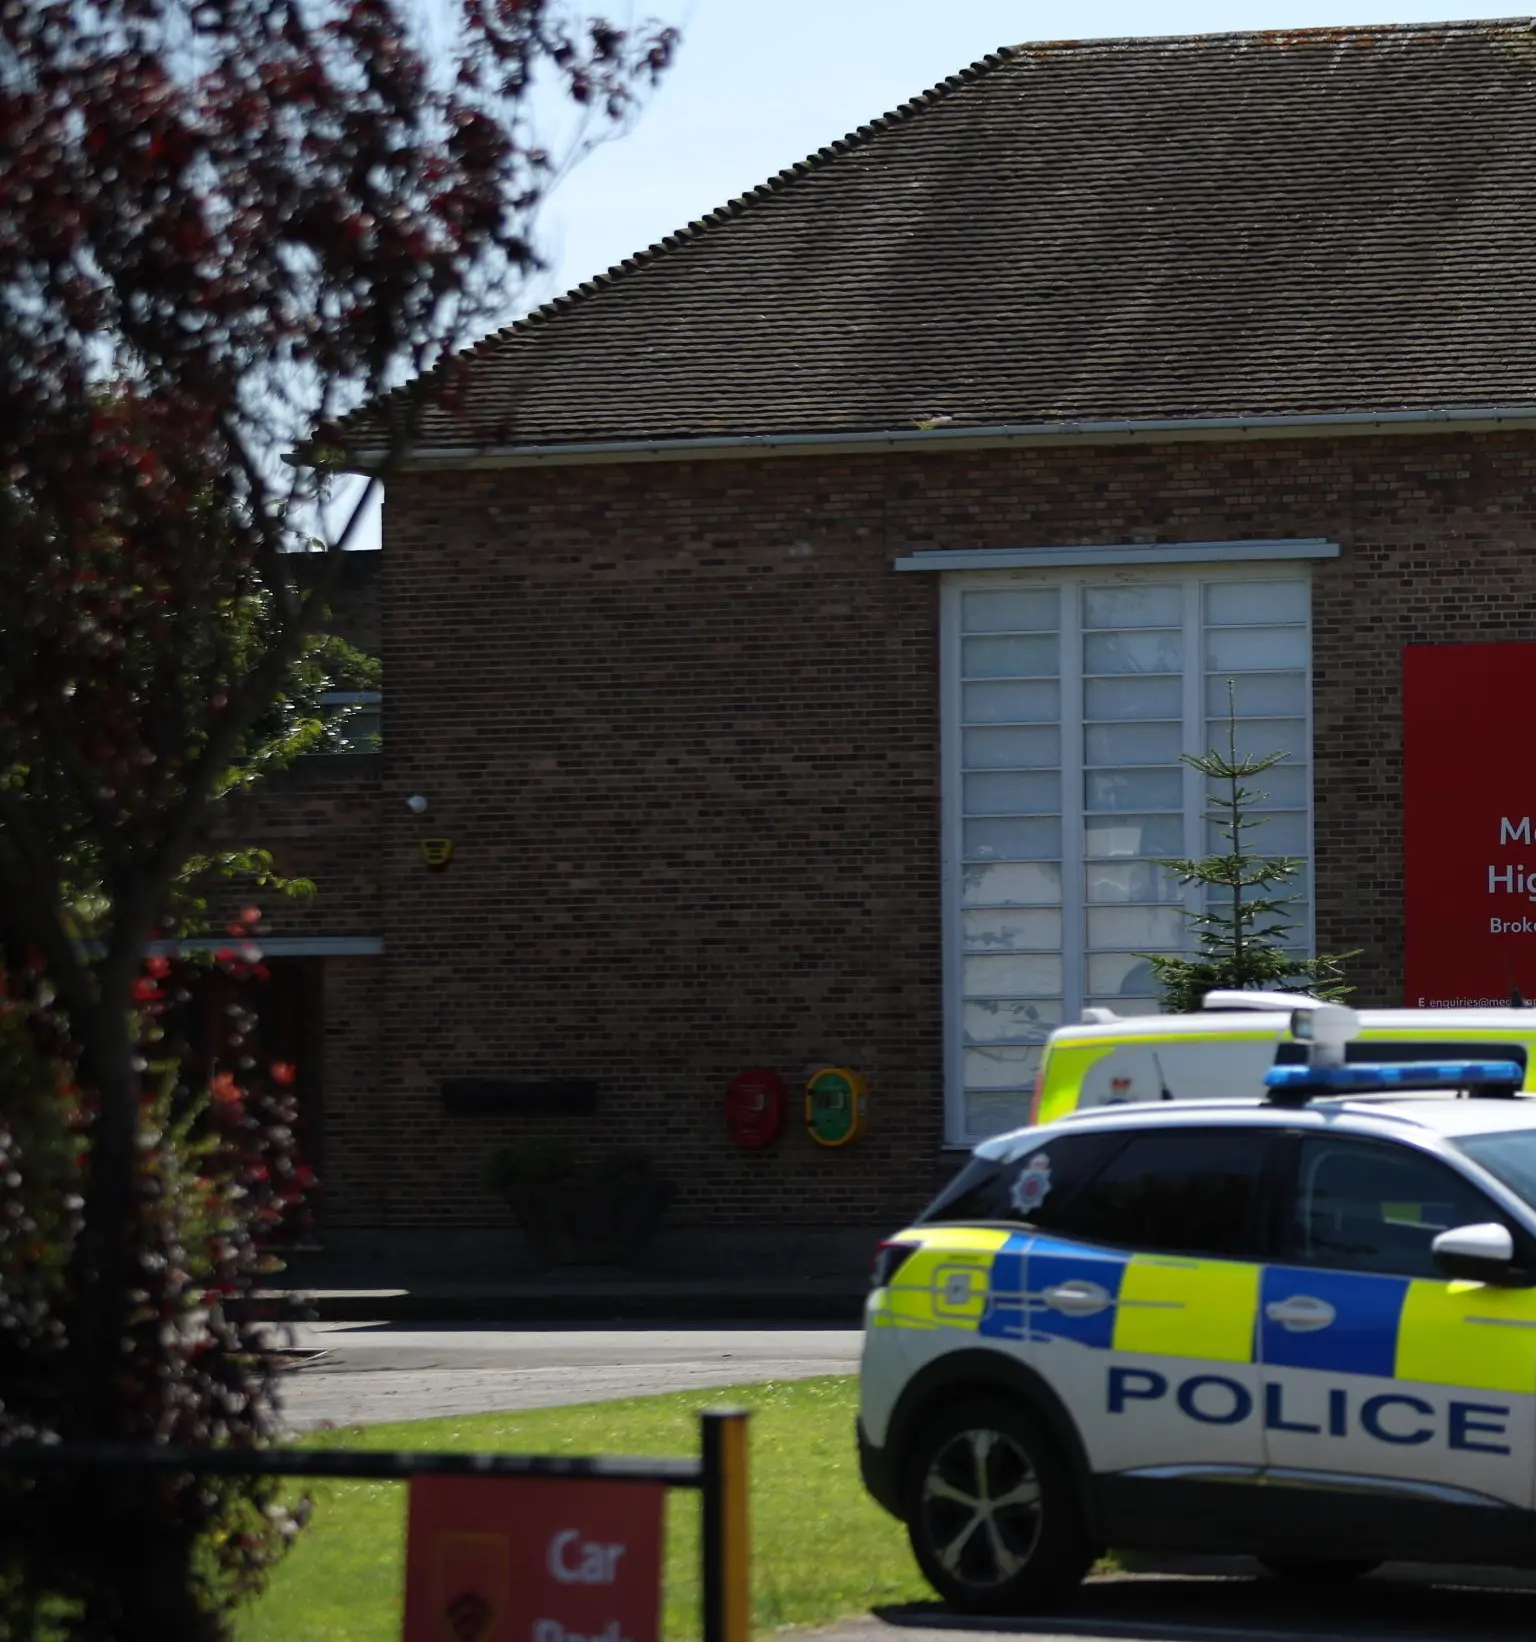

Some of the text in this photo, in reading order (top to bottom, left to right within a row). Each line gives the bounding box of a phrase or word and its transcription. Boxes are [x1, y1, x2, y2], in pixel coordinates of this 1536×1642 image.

[1418, 997, 1425, 1007] E
[1106, 1366, 1511, 1455] POLICE
[548, 1528, 626, 1584] Car
